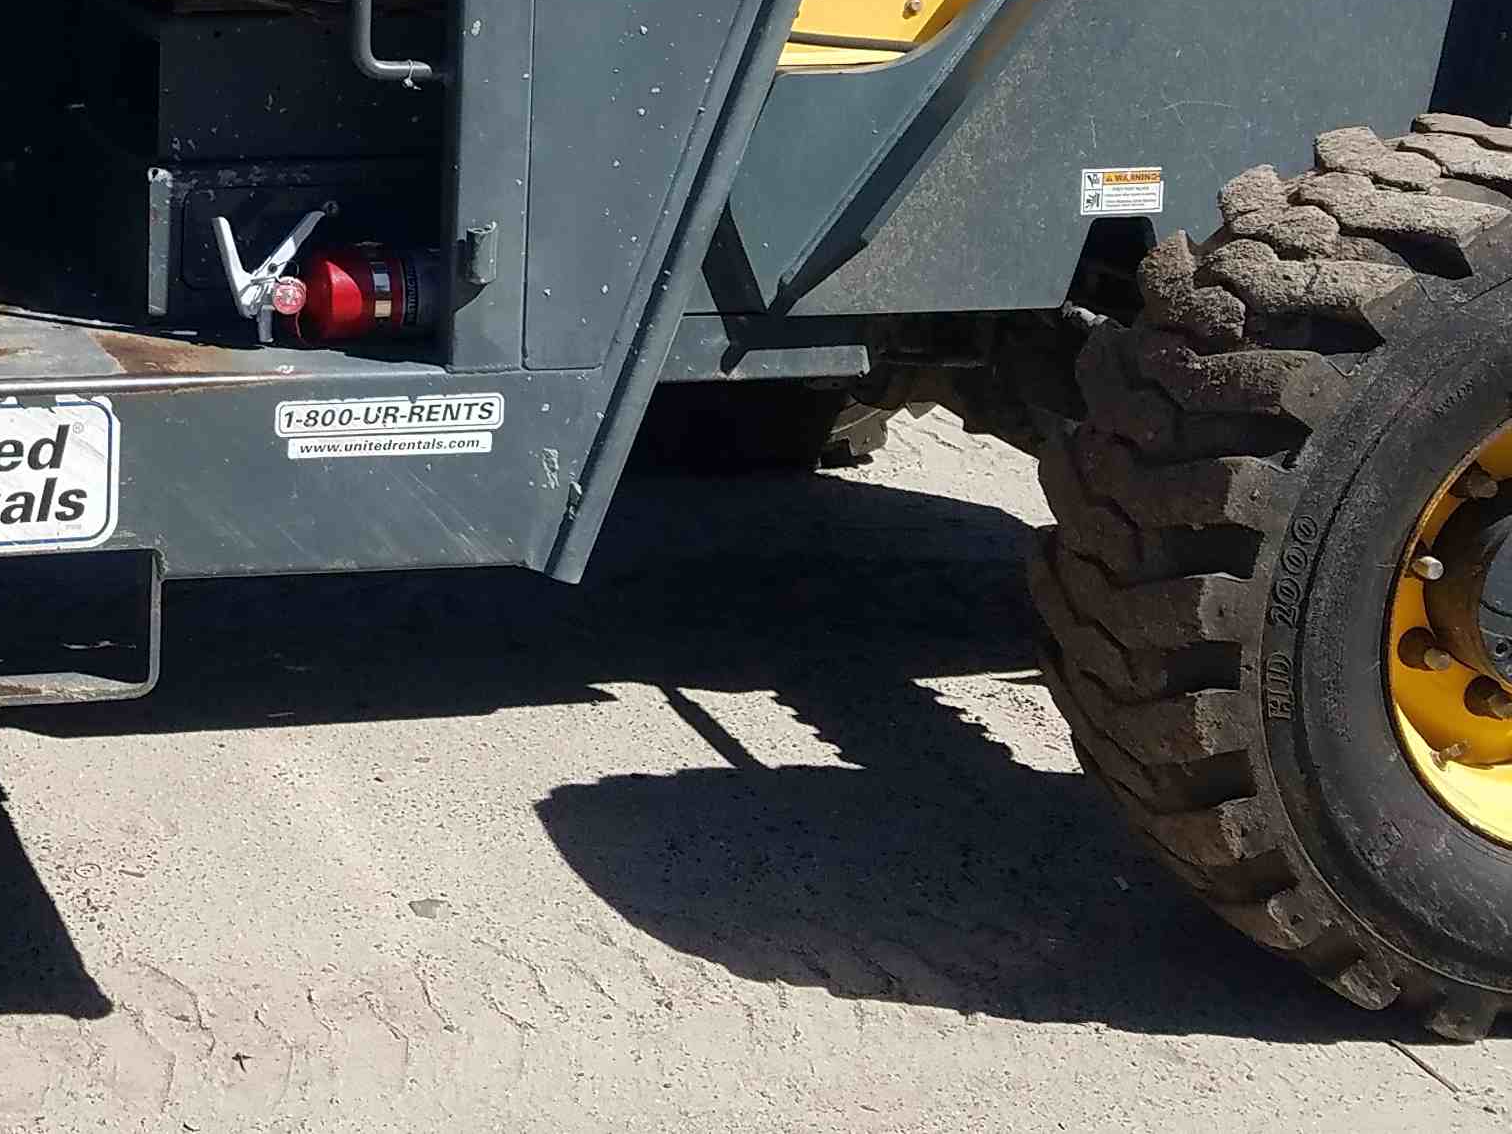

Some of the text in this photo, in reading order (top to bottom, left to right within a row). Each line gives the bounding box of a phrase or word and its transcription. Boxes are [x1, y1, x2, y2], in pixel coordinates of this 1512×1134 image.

[284, 402, 495, 428] 1-800-UR-RENTS
[299, 438, 480, 454] www.unitedrentals.com
[1270, 515, 1318, 627] 2000
